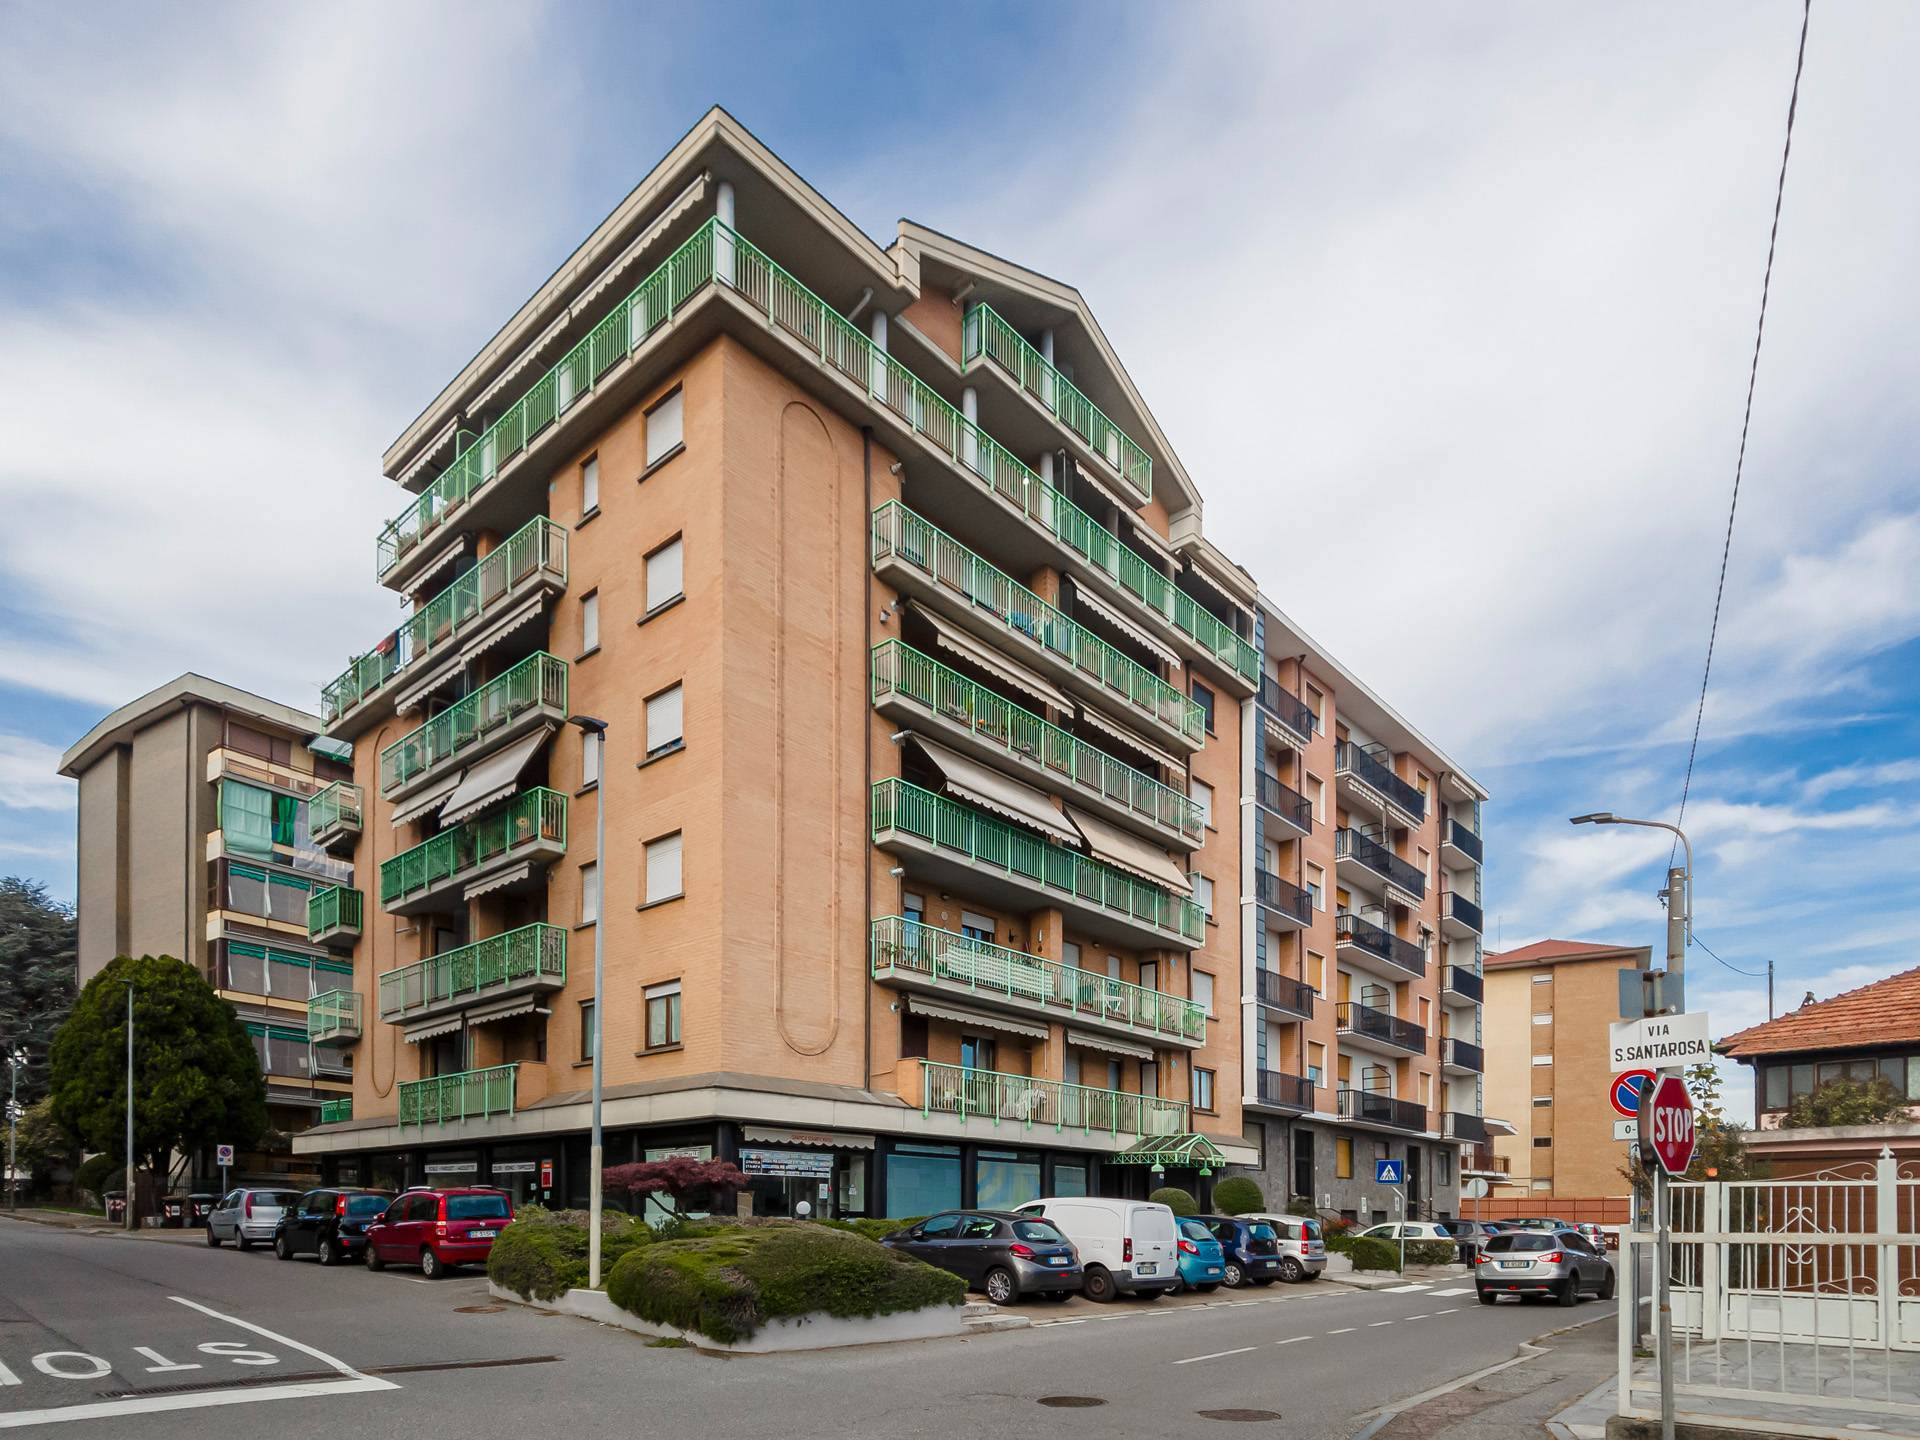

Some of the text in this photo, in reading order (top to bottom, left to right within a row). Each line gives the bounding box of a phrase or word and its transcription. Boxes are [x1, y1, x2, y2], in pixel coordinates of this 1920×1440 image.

[1648, 1024, 1670, 1037] VIA
[1615, 1039, 1705, 1062] S.SANTAROSA
[1656, 1106, 1693, 1143] STOP
